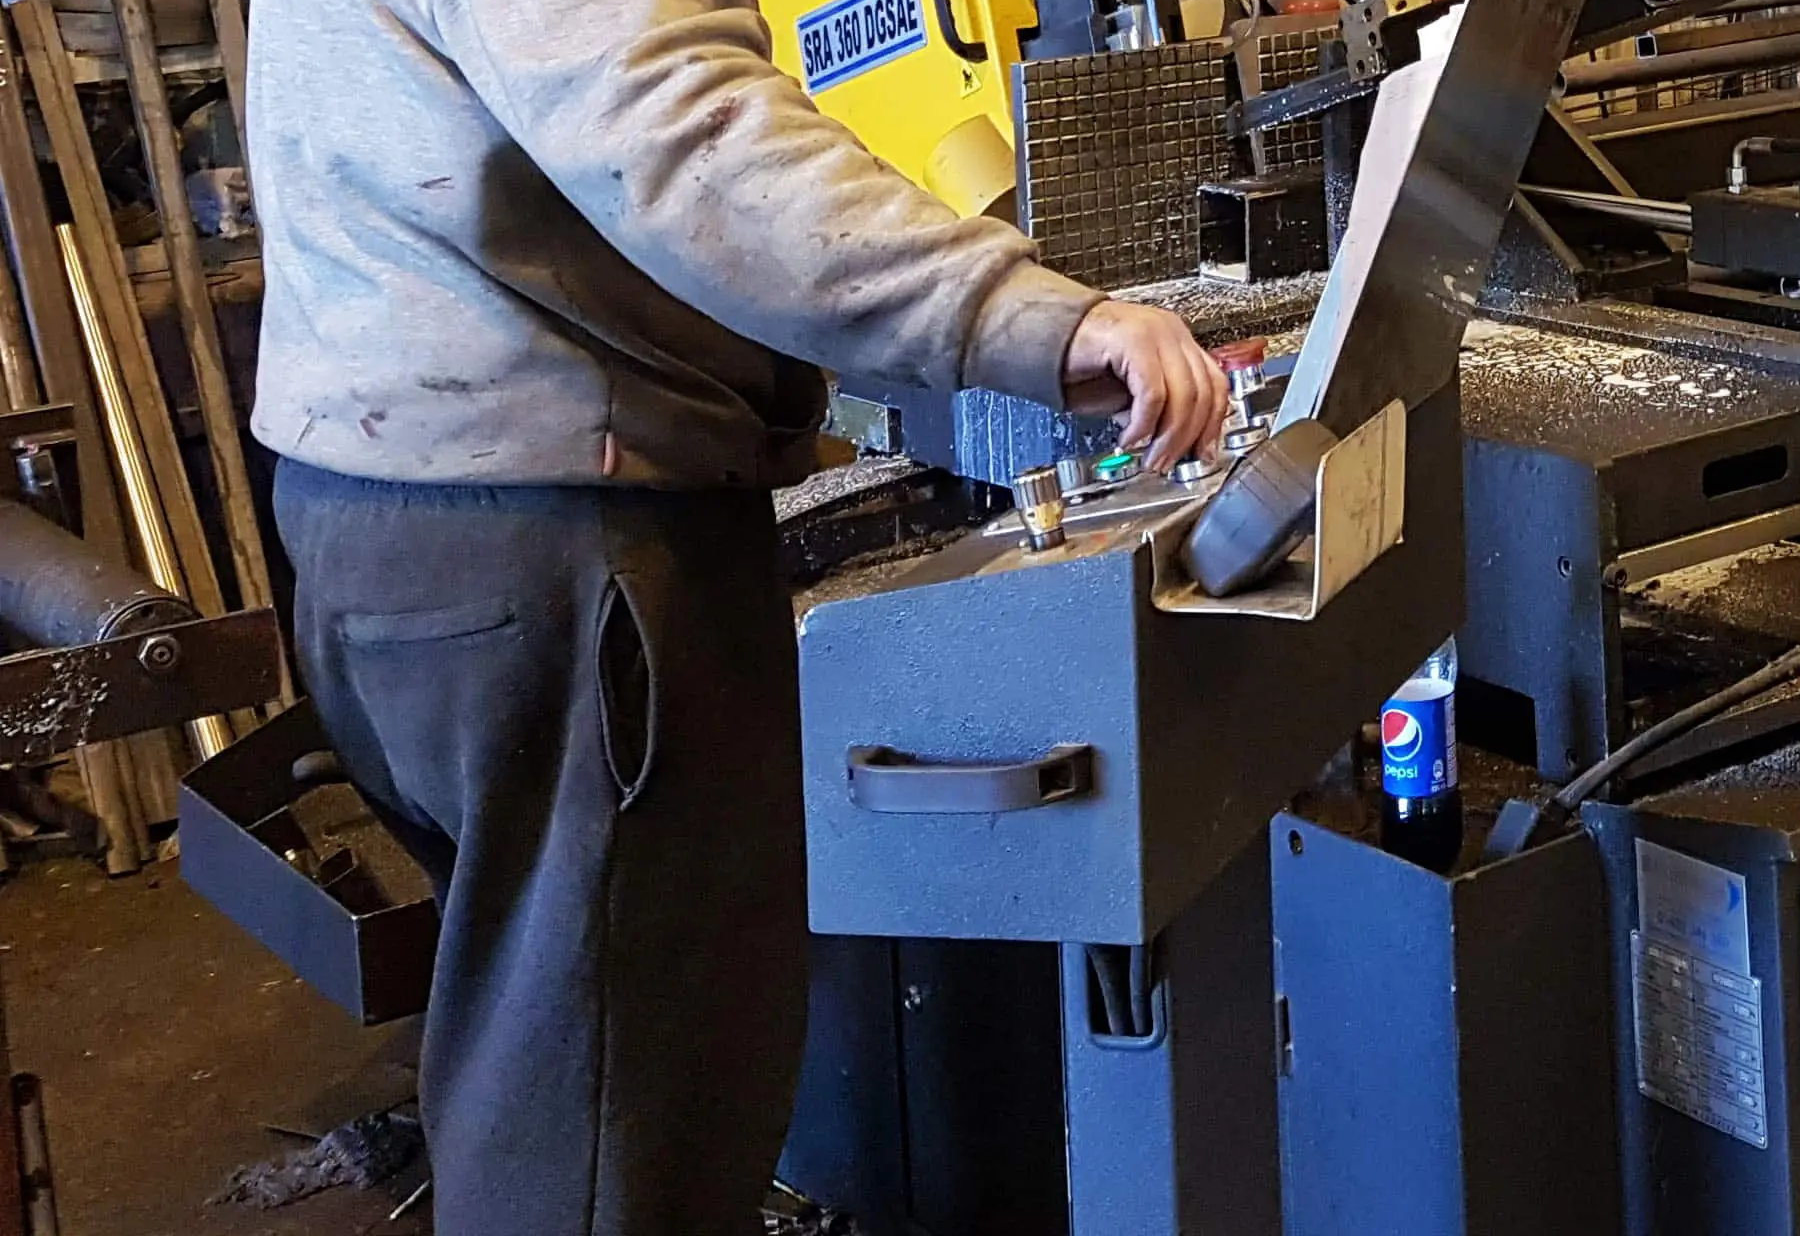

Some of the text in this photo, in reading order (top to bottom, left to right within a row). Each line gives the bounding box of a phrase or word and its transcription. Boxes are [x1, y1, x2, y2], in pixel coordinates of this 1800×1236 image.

[803, 24, 834, 77] SRA
[834, 10, 862, 63] 360
[1384, 763, 1418, 781] pepsi
